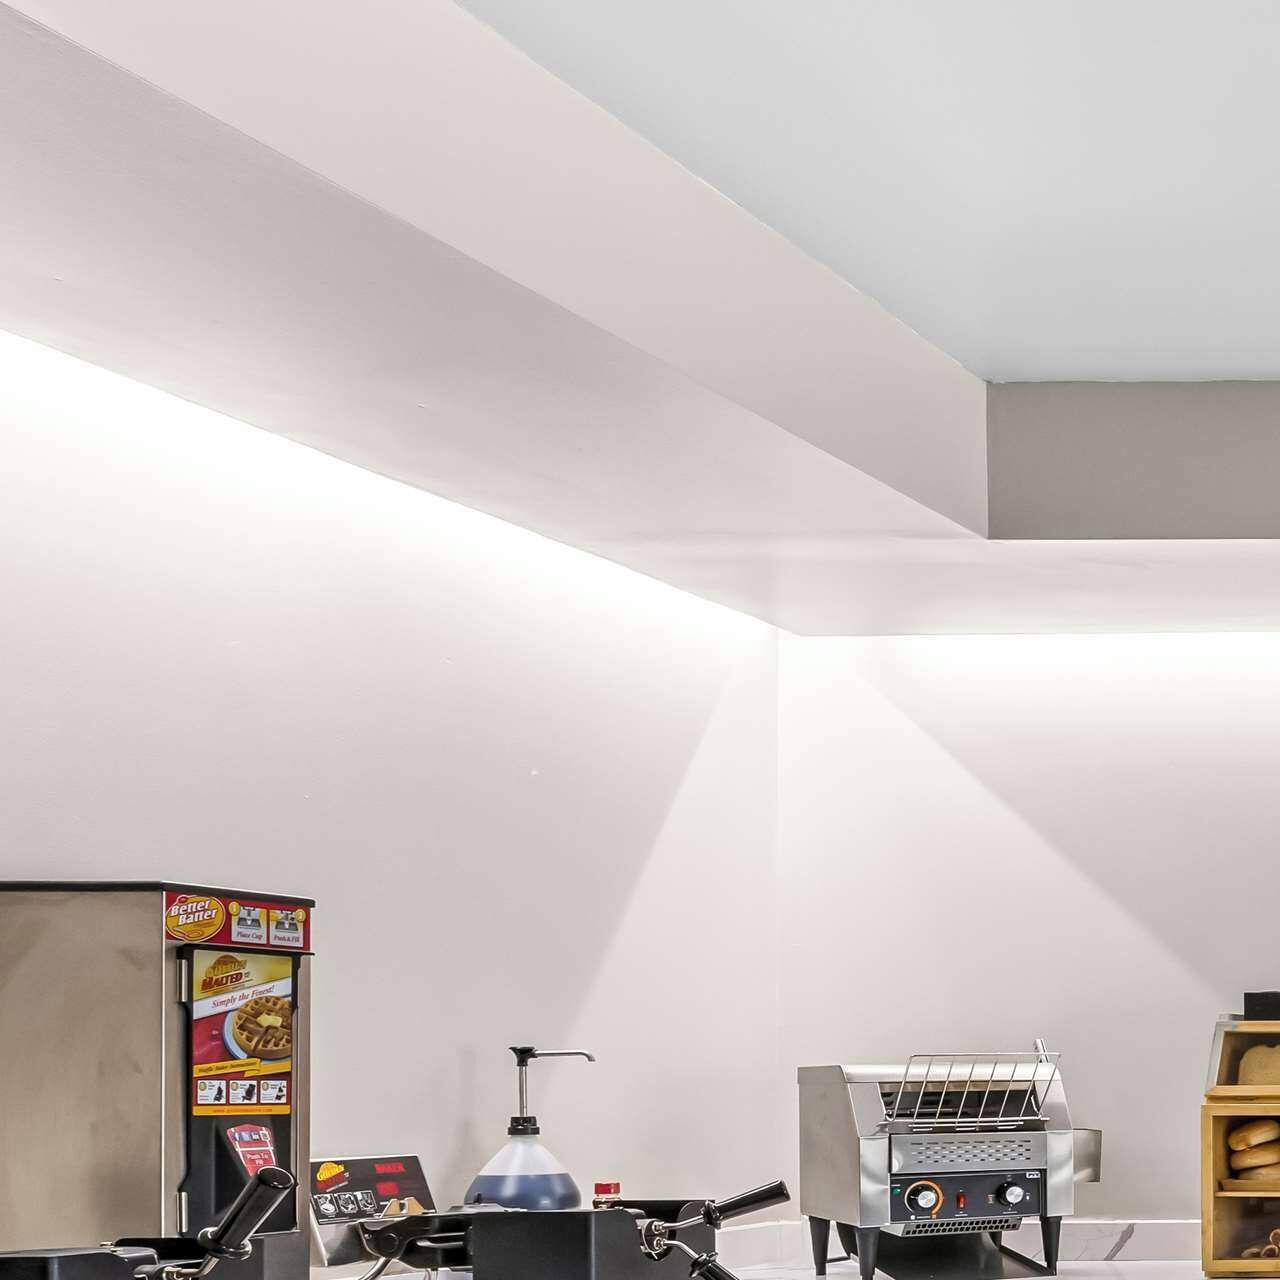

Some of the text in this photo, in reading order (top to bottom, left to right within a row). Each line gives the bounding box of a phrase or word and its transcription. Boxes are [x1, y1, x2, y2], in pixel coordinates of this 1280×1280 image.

[171, 900, 211, 916] Better
[178, 908, 218, 926] Batter
[212, 996, 237, 1008] Simply
[239, 992, 249, 1001] the
